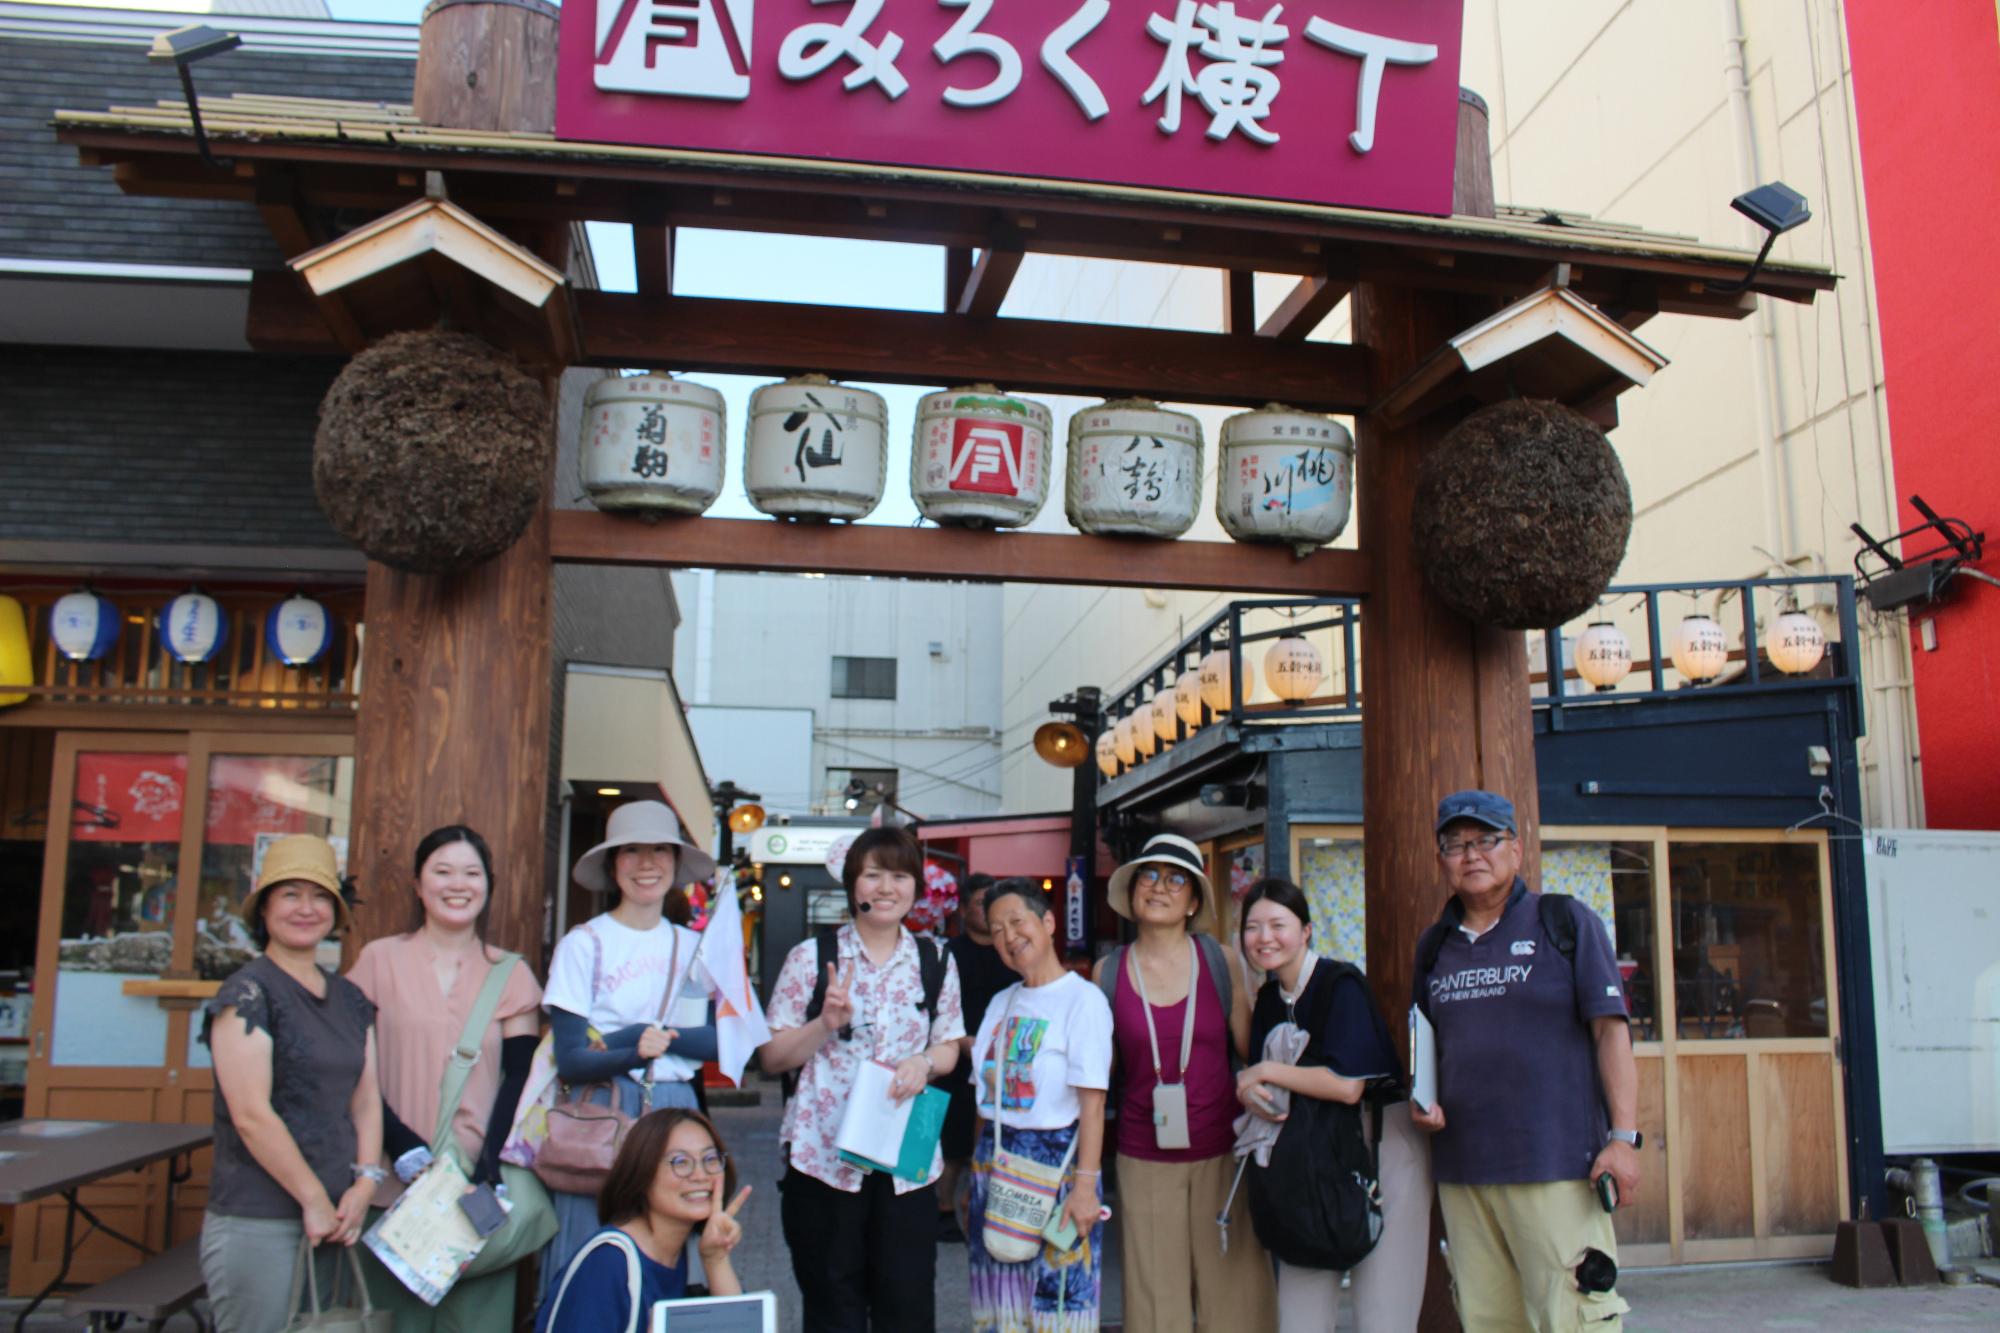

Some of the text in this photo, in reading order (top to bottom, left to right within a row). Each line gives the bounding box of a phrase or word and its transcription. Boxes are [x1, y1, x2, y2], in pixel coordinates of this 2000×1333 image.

[1430, 964, 1533, 997] CANTERBURY
[1451, 989, 1470, 1001] NEW
[1470, 985, 1507, 999] ZEALAND
